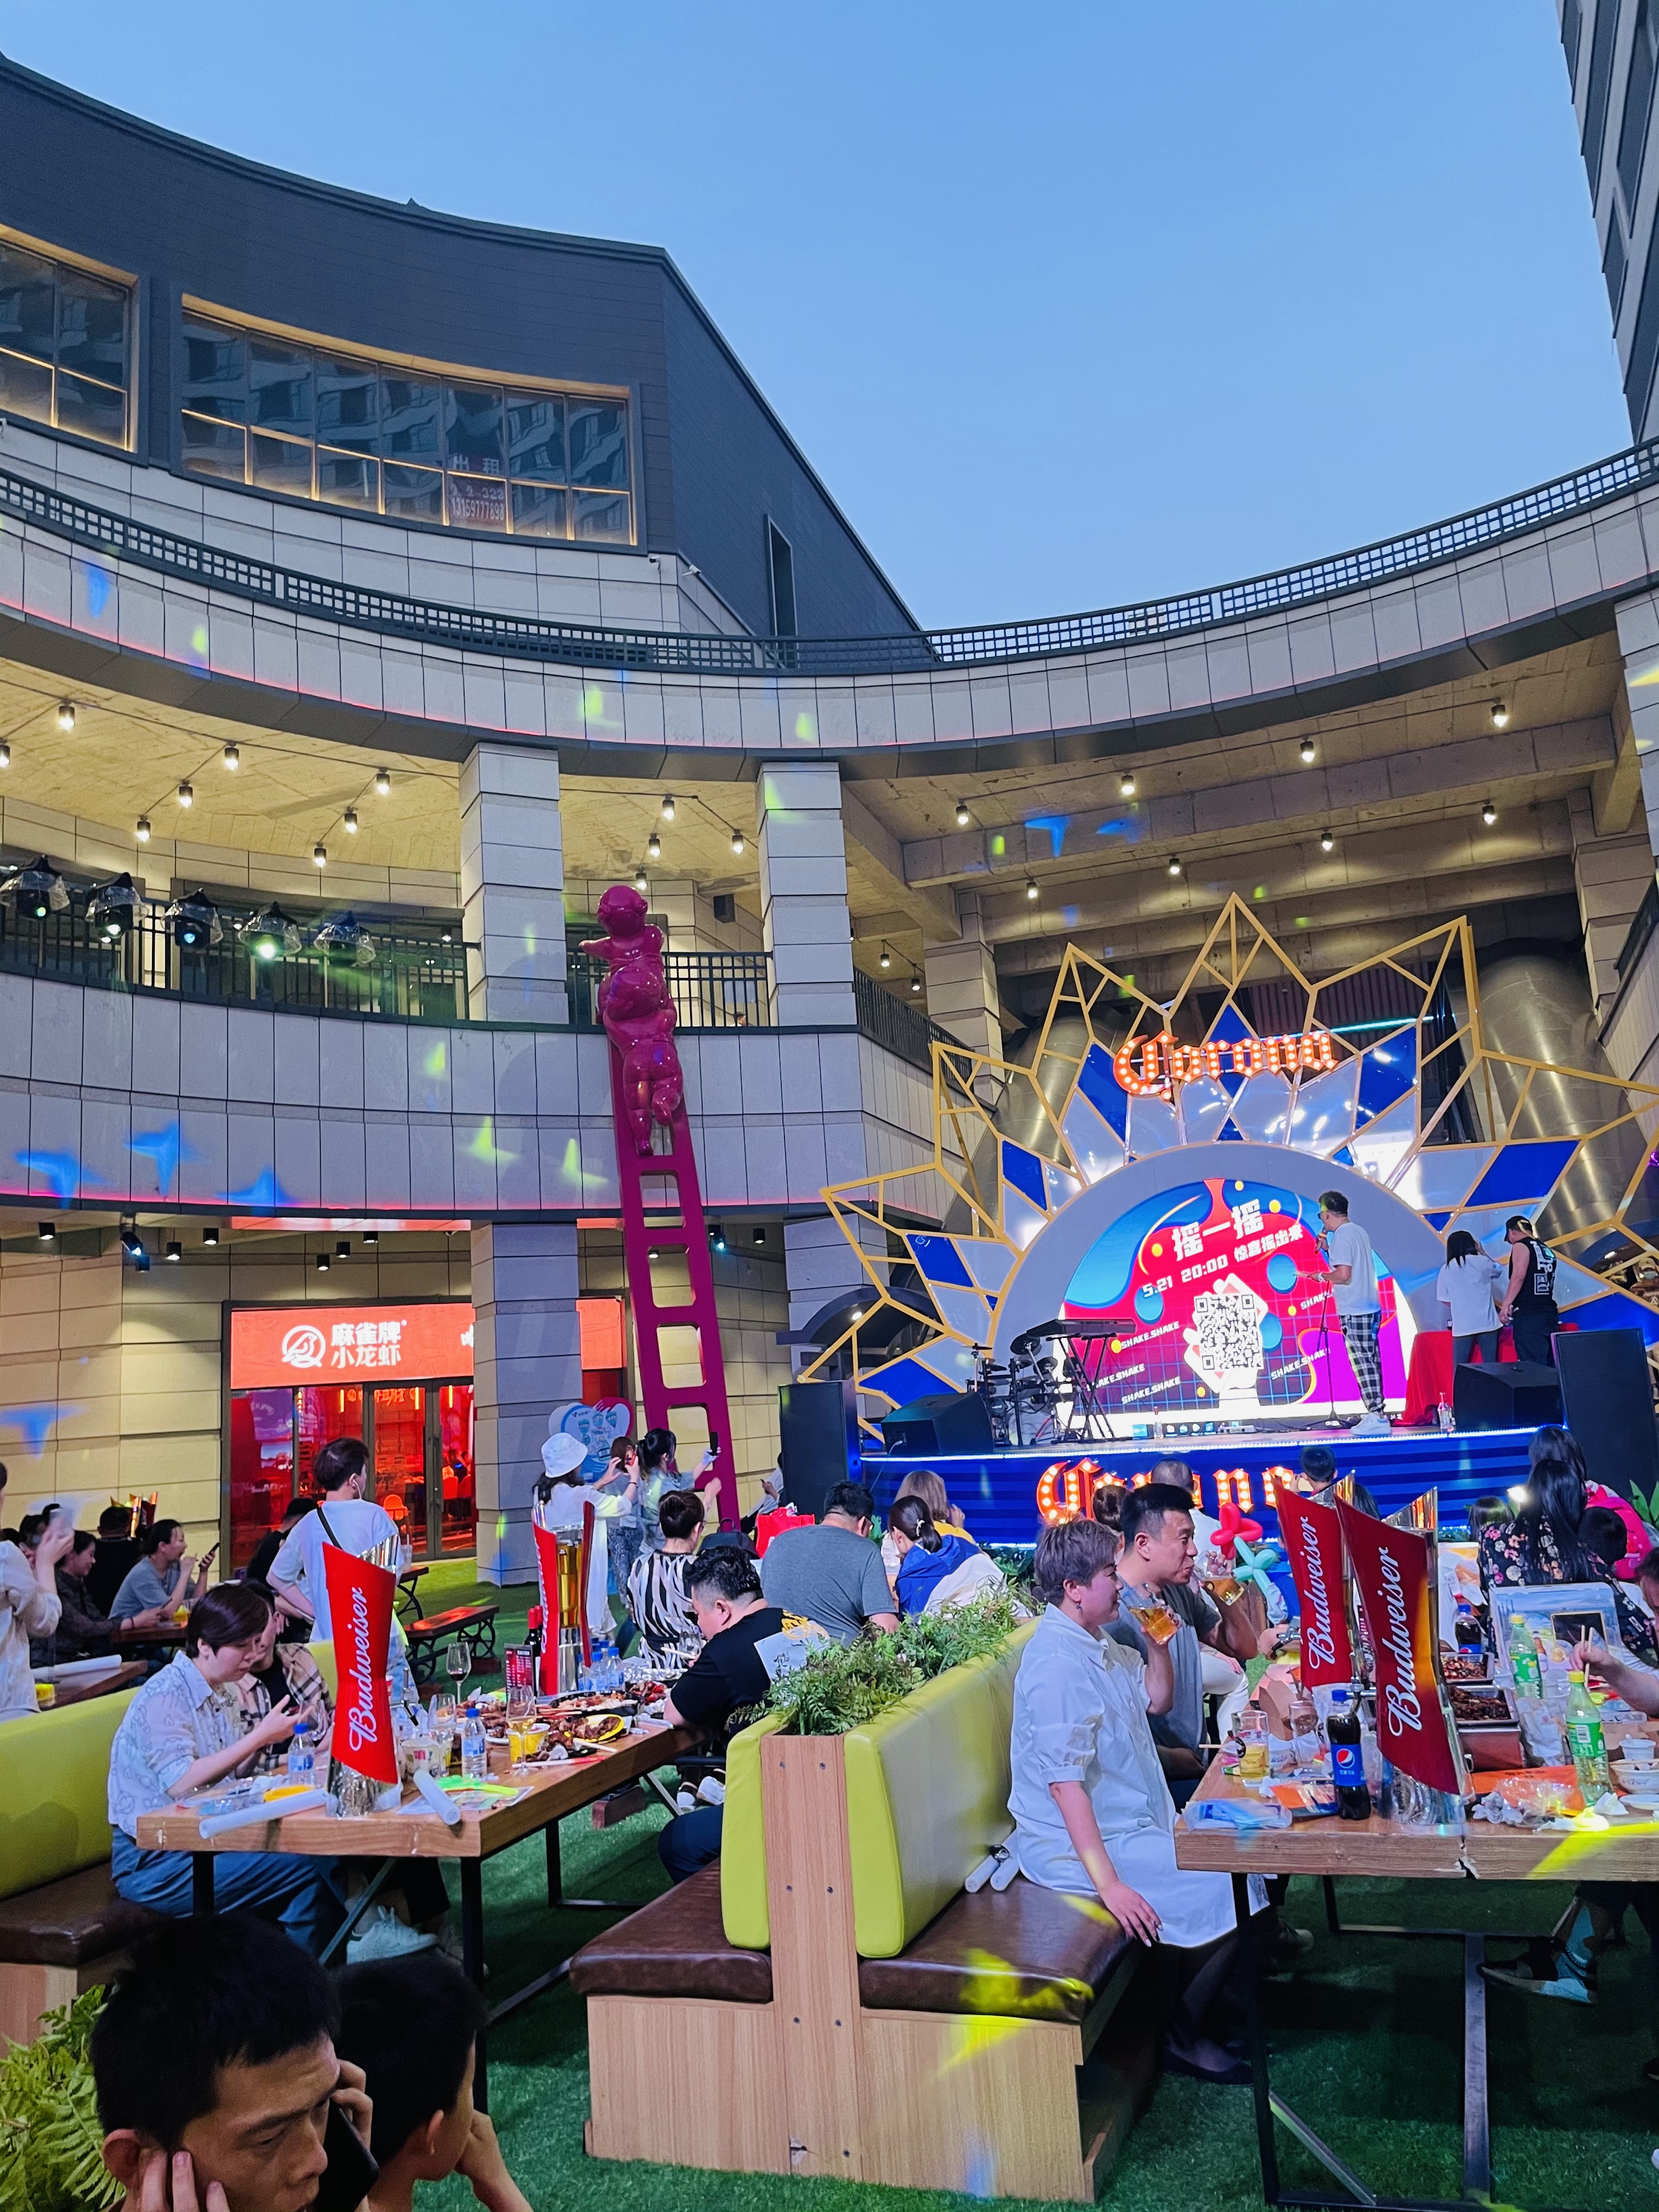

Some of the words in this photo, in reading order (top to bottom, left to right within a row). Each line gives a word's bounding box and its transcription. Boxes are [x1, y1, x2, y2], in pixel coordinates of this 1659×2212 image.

[1113, 1030, 1339, 1099] Corona
[1171, 1198, 1264, 1262] 摇一摇
[1143, 1274, 1173, 1297] 5.21
[1181, 1254, 1228, 1283] 20:00
[331, 1322, 402, 1347] 麻雀牌
[331, 1345, 402, 1369] 小龙虾
[1121, 1321, 1180, 1350] SHAKE.SHAKE
[1121, 1376, 1181, 1404] SHAKE.SHAKE
[1300, 1516, 1336, 1670] Budweiser
[1377, 1546, 1423, 1737] Budweiser
[347, 1587, 377, 1752] Budweiser
